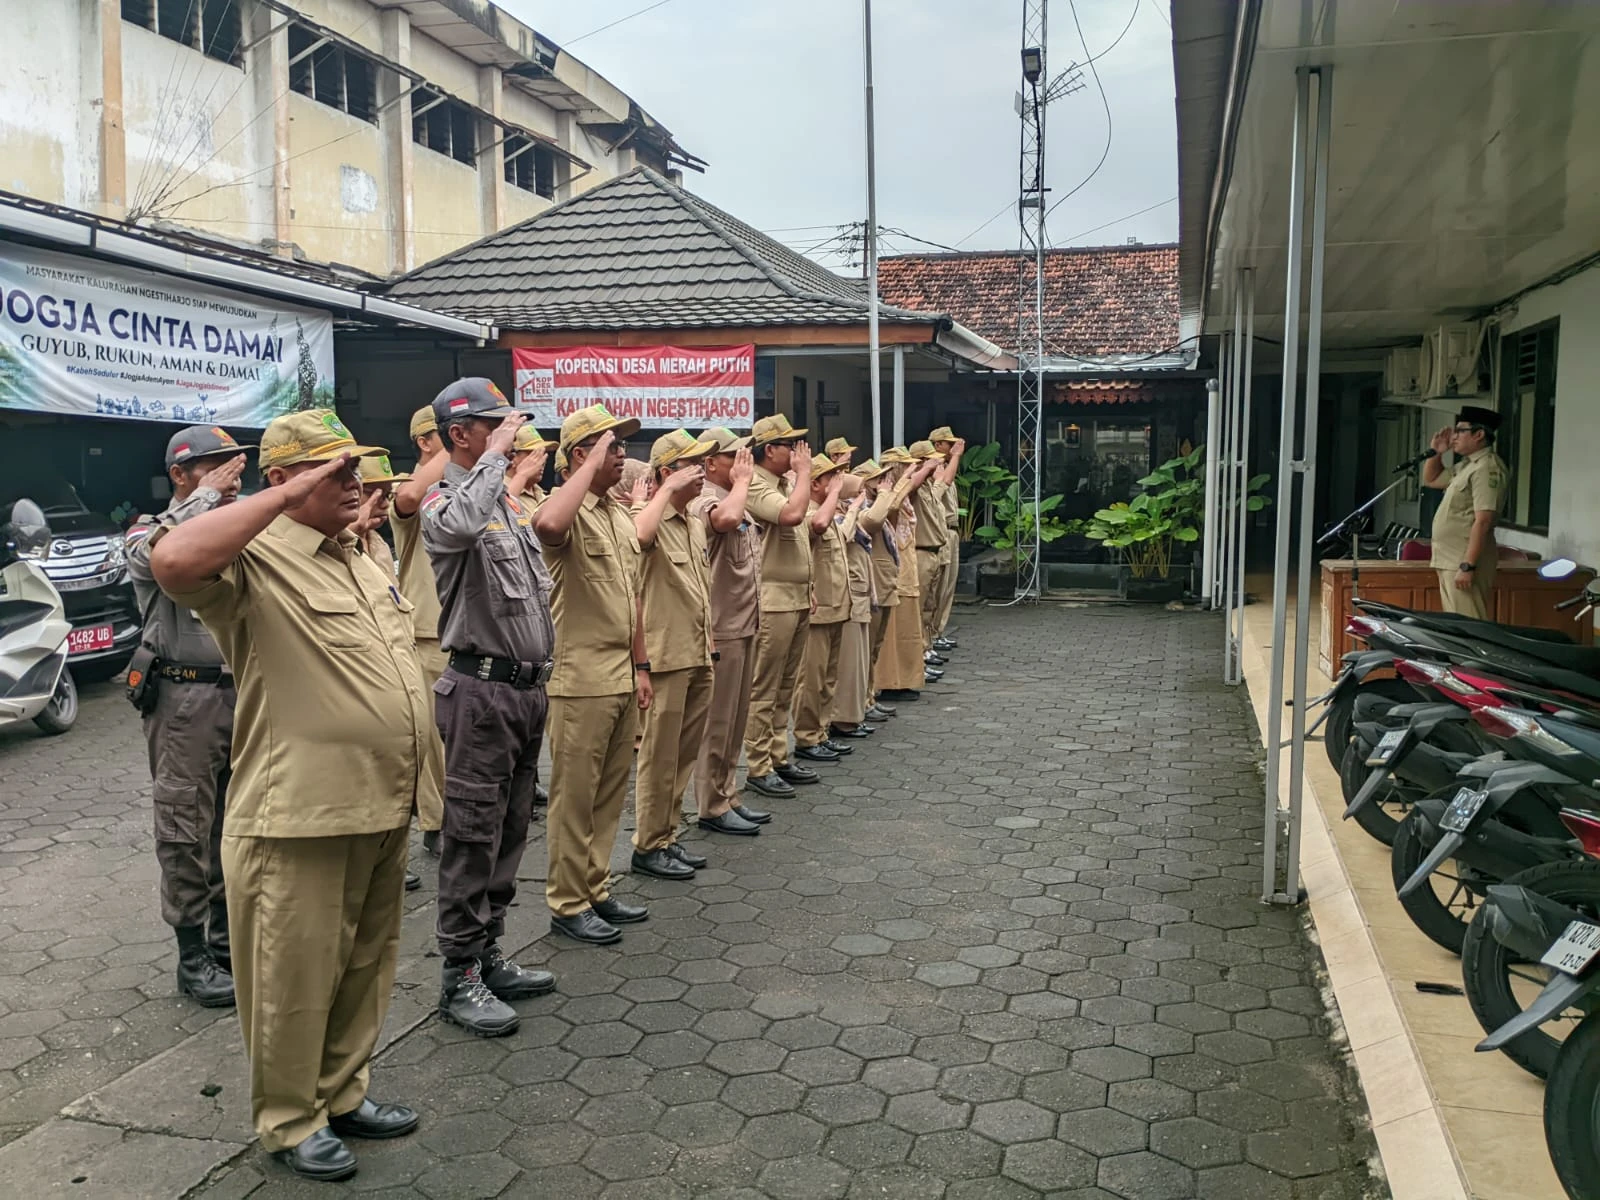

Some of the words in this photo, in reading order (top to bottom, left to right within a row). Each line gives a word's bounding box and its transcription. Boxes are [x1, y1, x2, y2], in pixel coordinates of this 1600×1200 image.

[26, 265, 85, 286] MASYARAKAT
[86, 277, 138, 295] KALURAHAN
[139, 286, 191, 306] NGESTIHARJO
[192, 298, 208, 309] SIAP
[208, 302, 257, 319] MEWUJUDKAN
[109, 308, 197, 350] CINTA
[203, 324, 283, 362] DAMAI
[20, 334, 90, 360] GUYUB,
[95, 344, 156, 369] RUKUN,
[160, 354, 202, 373] AMAN
[205, 361, 216, 376] &
[219, 362, 260, 381] DAMAI
[555, 357, 618, 374] KOPERASI
[622, 357, 656, 374] DESA
[659, 357, 706, 374] MERAH
[709, 356, 750, 373] PUTIH
[556, 398, 643, 418] KAAHAN
[646, 397, 750, 418] NGESTIHARJO
[70, 630, 95, 646] 1482
[97, 627, 110, 641] UB
